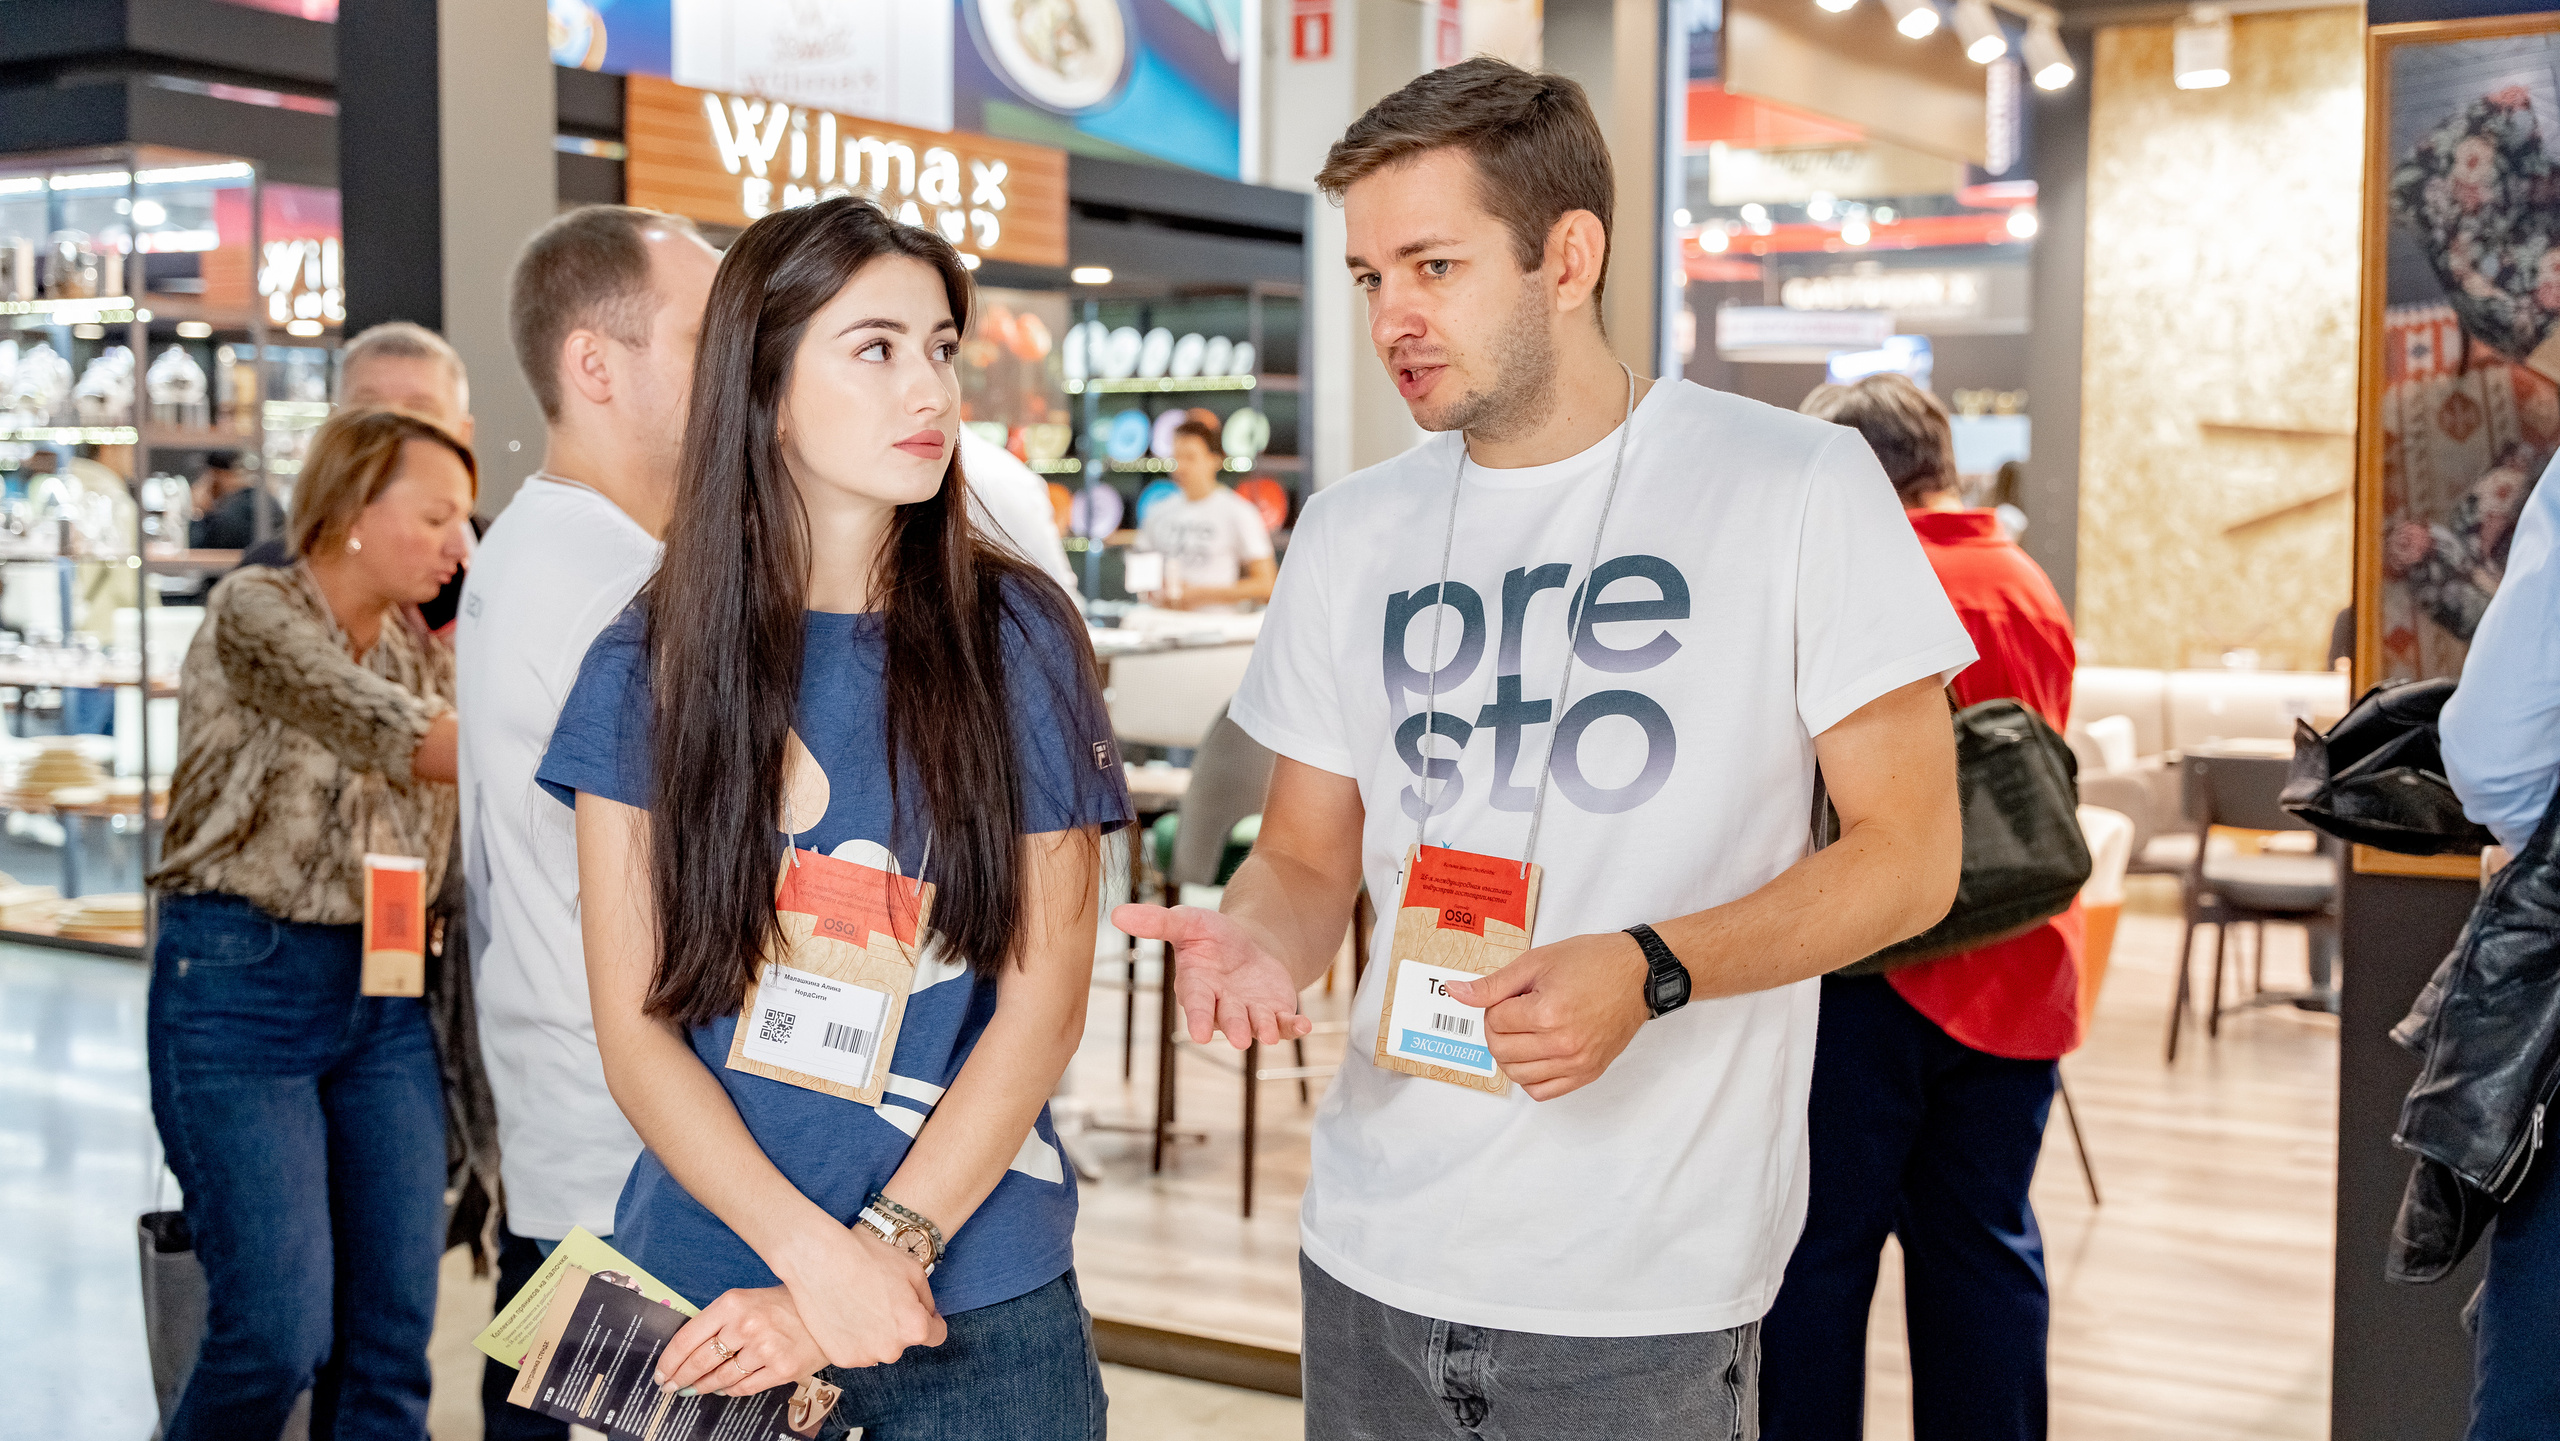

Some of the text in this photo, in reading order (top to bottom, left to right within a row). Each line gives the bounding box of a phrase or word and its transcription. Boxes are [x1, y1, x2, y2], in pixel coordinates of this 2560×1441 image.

[704, 92, 1009, 211] Wilmax
[1382, 553, 1691, 727] pre
[1394, 673, 1677, 822] sto
[823, 917, 855, 935] OSQ
[1444, 908, 1472, 924] OSQ
[783, 973, 820, 987] Малашкина
[820, 982, 841, 992] Алина
[794, 988, 827, 1001] НордСити
[1410, 1036, 1484, 1063] ЭКСПОНЕНТ
[514, 1286, 541, 1316] пряников
[545, 1254, 569, 1280] палочке
[521, 1359, 540, 1393] Программа
